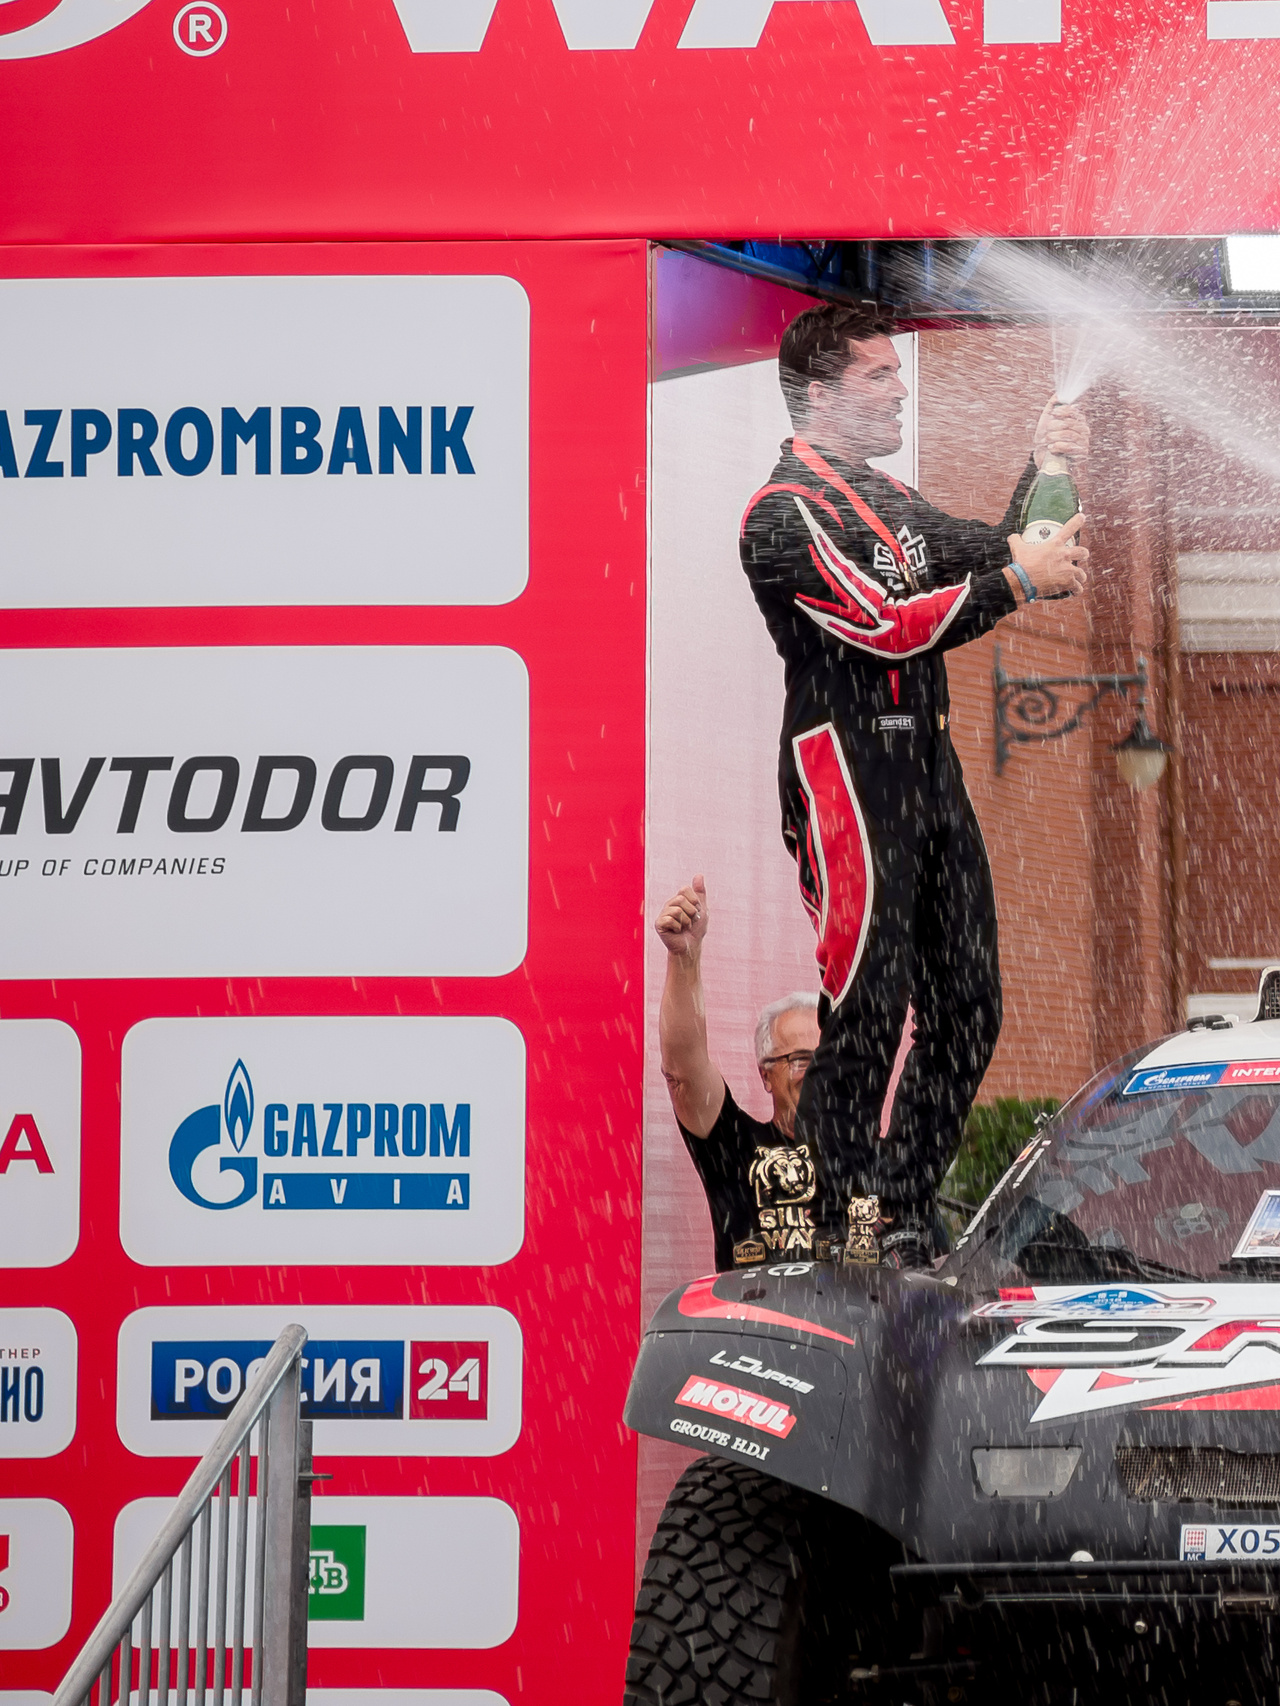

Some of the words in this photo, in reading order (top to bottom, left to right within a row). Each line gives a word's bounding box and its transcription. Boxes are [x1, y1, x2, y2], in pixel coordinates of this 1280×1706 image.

[42, 859, 71, 876] OF
[83, 857, 226, 876] COMPANIES
[263, 1103, 471, 1157] GAZPROM
[758, 1206, 816, 1230] SILK
[760, 1228, 817, 1252] WAY
[417, 1358, 481, 1401] 24
[681, 1381, 790, 1432] MOTUL
[670, 1418, 731, 1447] GROUPE
[1186, 1553, 1202, 1561] MC
